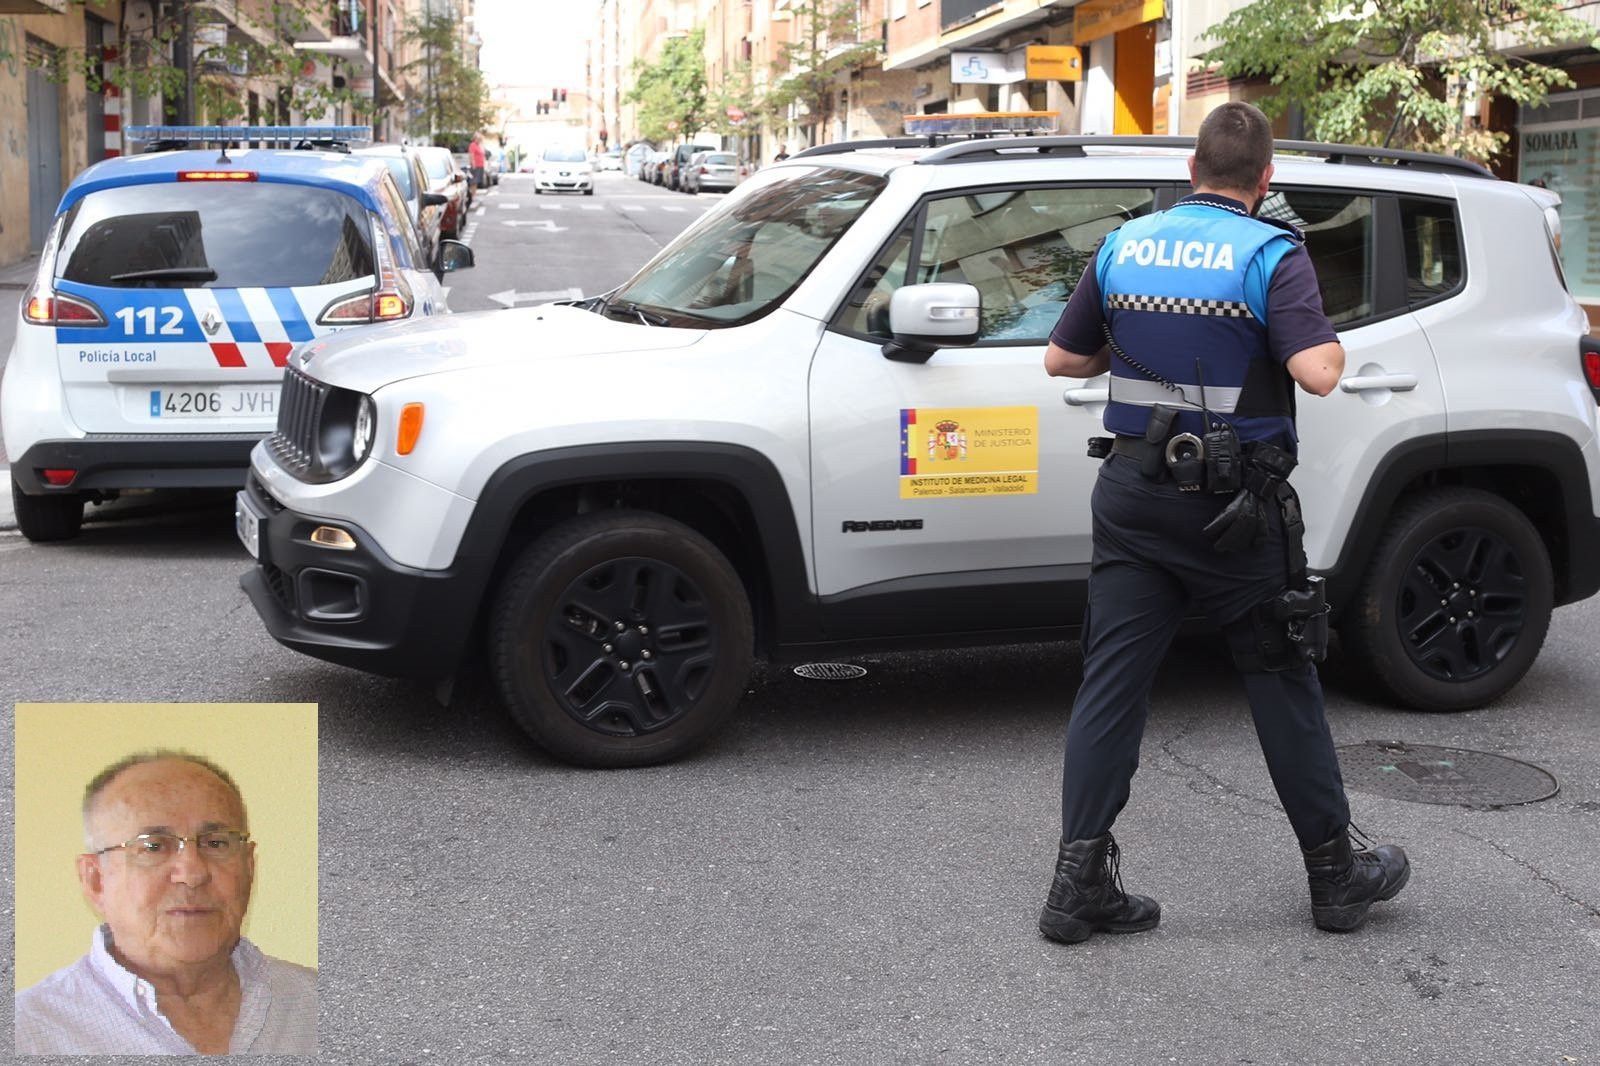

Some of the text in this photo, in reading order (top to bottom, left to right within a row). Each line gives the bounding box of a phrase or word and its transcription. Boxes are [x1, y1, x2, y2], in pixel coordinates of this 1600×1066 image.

[1525, 131, 1578, 151] SOMARA
[1117, 239, 1234, 270] POLICIA
[115, 306, 184, 336] 112
[124, 350, 157, 362] Local
[165, 392, 274, 413] 4206 JVH
[974, 428, 1031, 437] MINISTERIO
[974, 439, 1031, 448] DE JUSTICIA
[910, 475, 1027, 486] INSTITUTO DE MEDICINA LEGAL
[949, 486, 986, 495] Salamanca
